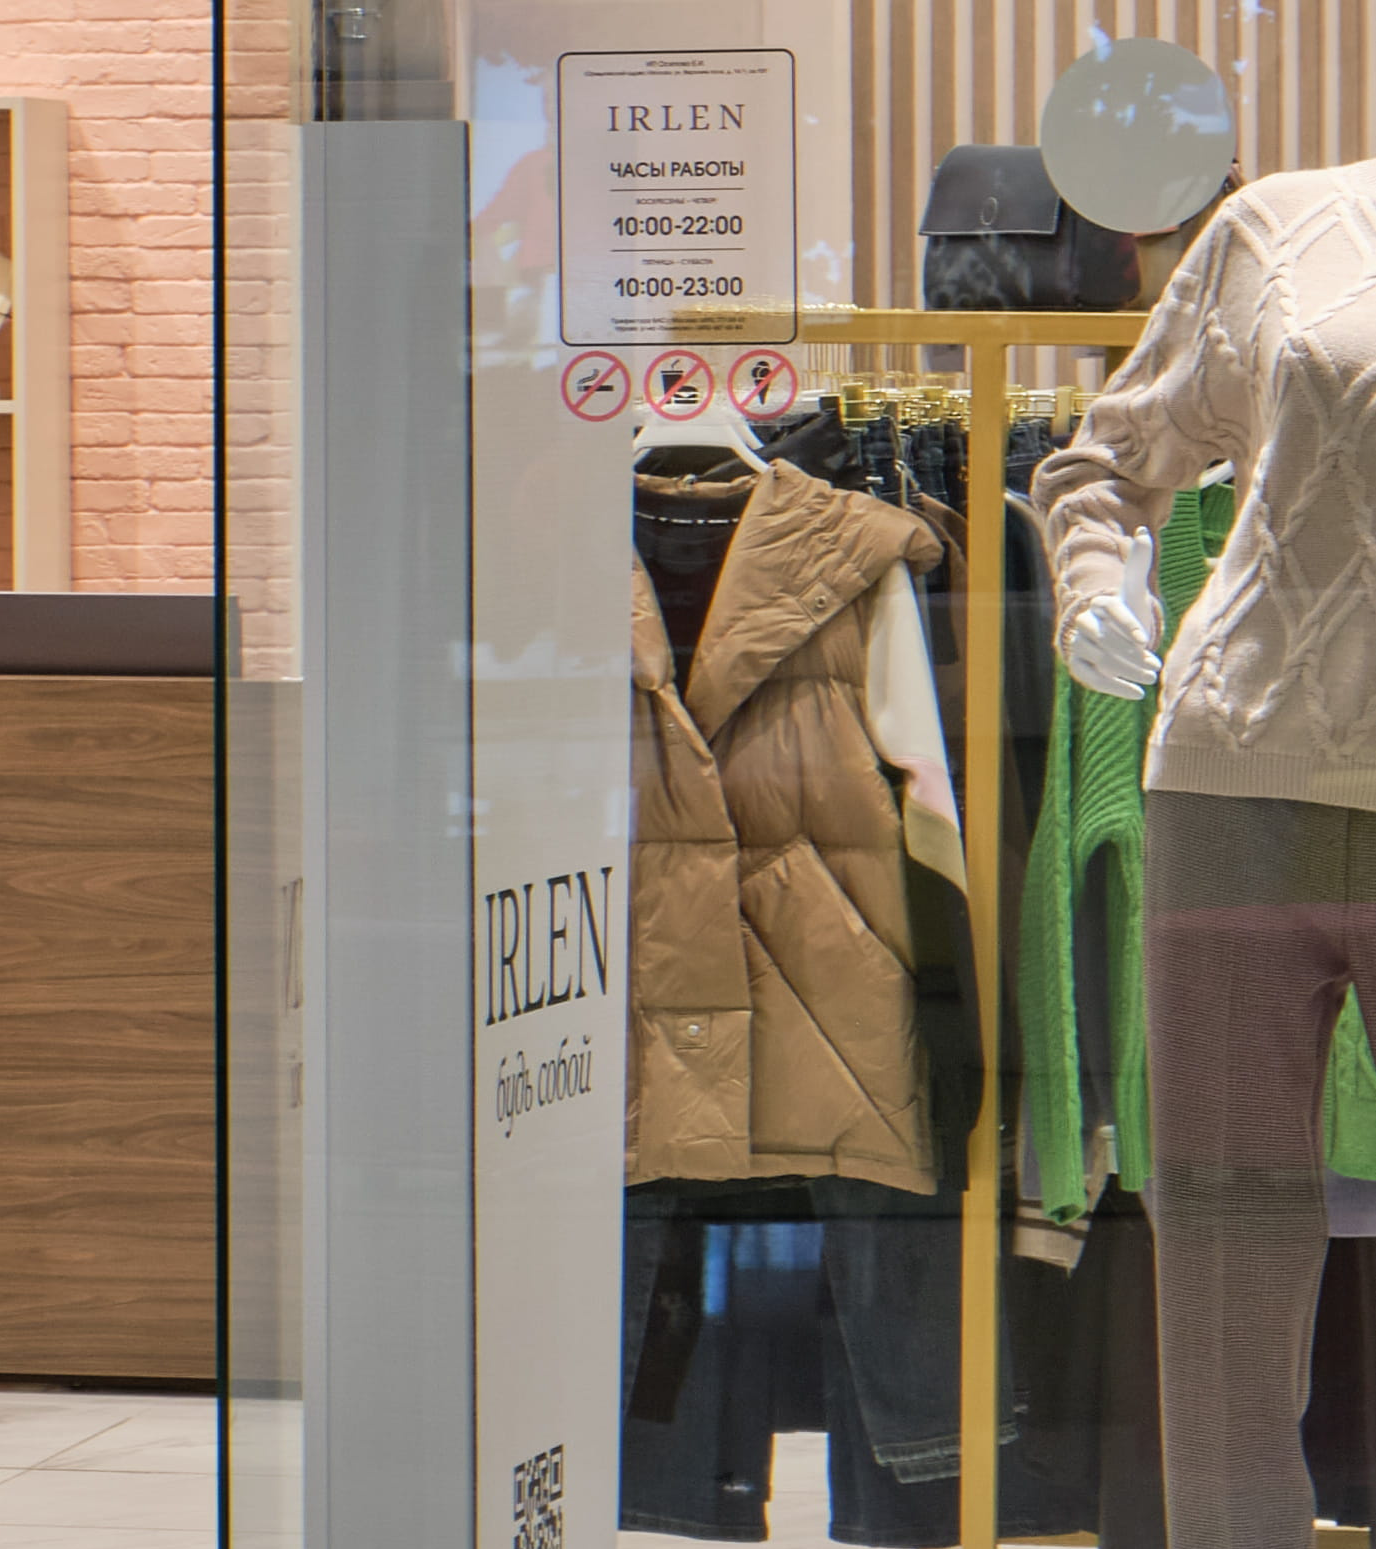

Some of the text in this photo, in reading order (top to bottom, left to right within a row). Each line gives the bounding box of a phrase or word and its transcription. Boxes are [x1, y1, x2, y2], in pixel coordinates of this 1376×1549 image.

[607, 104, 745, 131] IRLEN
[610, 161, 744, 178] ЧАСЫ РАБОТЫ
[613, 215, 743, 236] 10:00-22:00
[614, 277, 744, 297] 10:00-23:00
[486, 867, 613, 1026] IRLEN
[497, 1034, 591, 1138] будь собой
